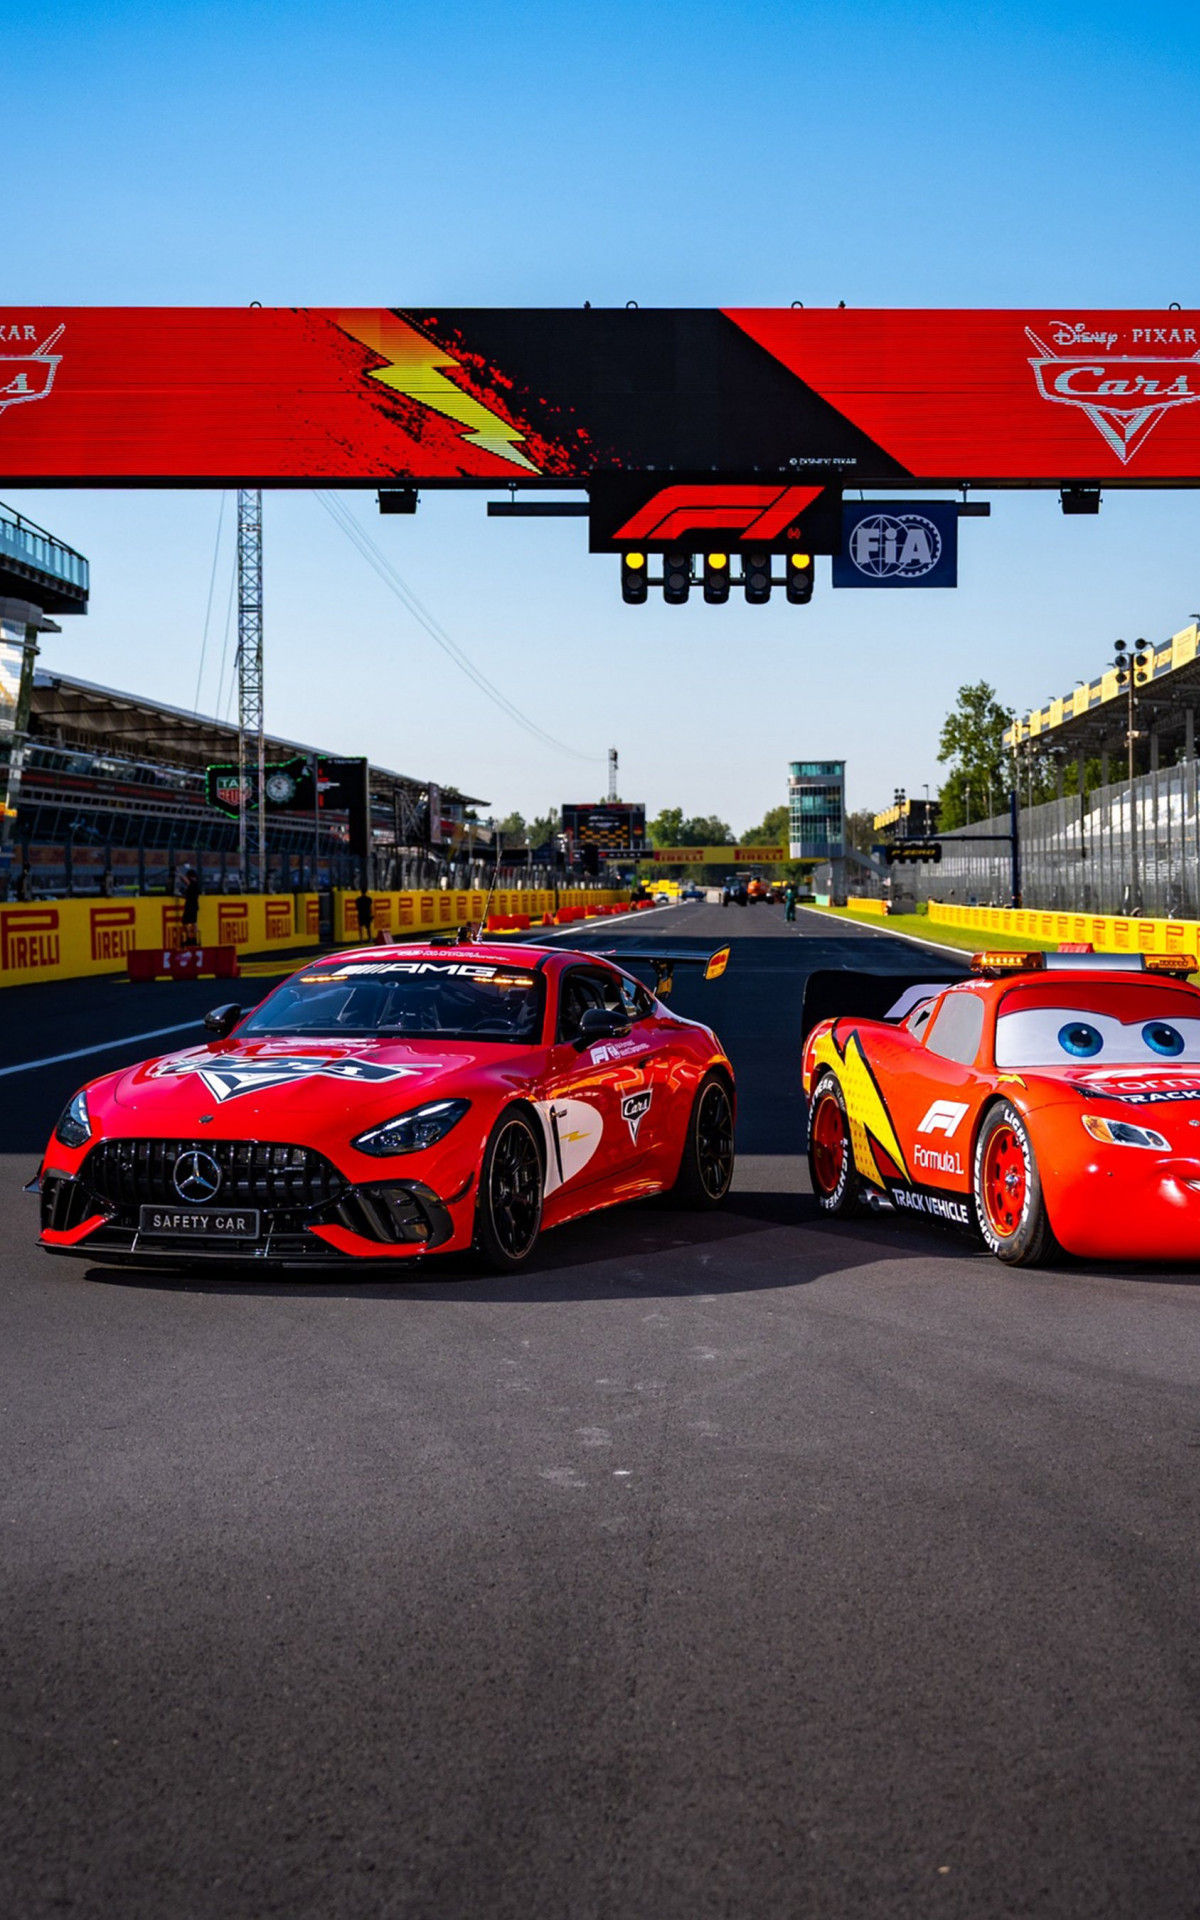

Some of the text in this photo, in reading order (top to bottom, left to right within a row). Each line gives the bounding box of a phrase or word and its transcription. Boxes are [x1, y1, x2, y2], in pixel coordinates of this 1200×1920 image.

[1049, 321, 1197, 350] Disney PIXAR
[1054, 366, 1195, 395] Cars
[218, 903, 248, 945] PIRELLI
[265, 901, 291, 940] PIRELLI
[0, 909, 59, 970] PIRELLI
[624, 1099, 648, 1116] Cars
[153, 1214, 246, 1230] SAFETY CAR
[892, 1188, 970, 1224] TRACK VEHICLE
